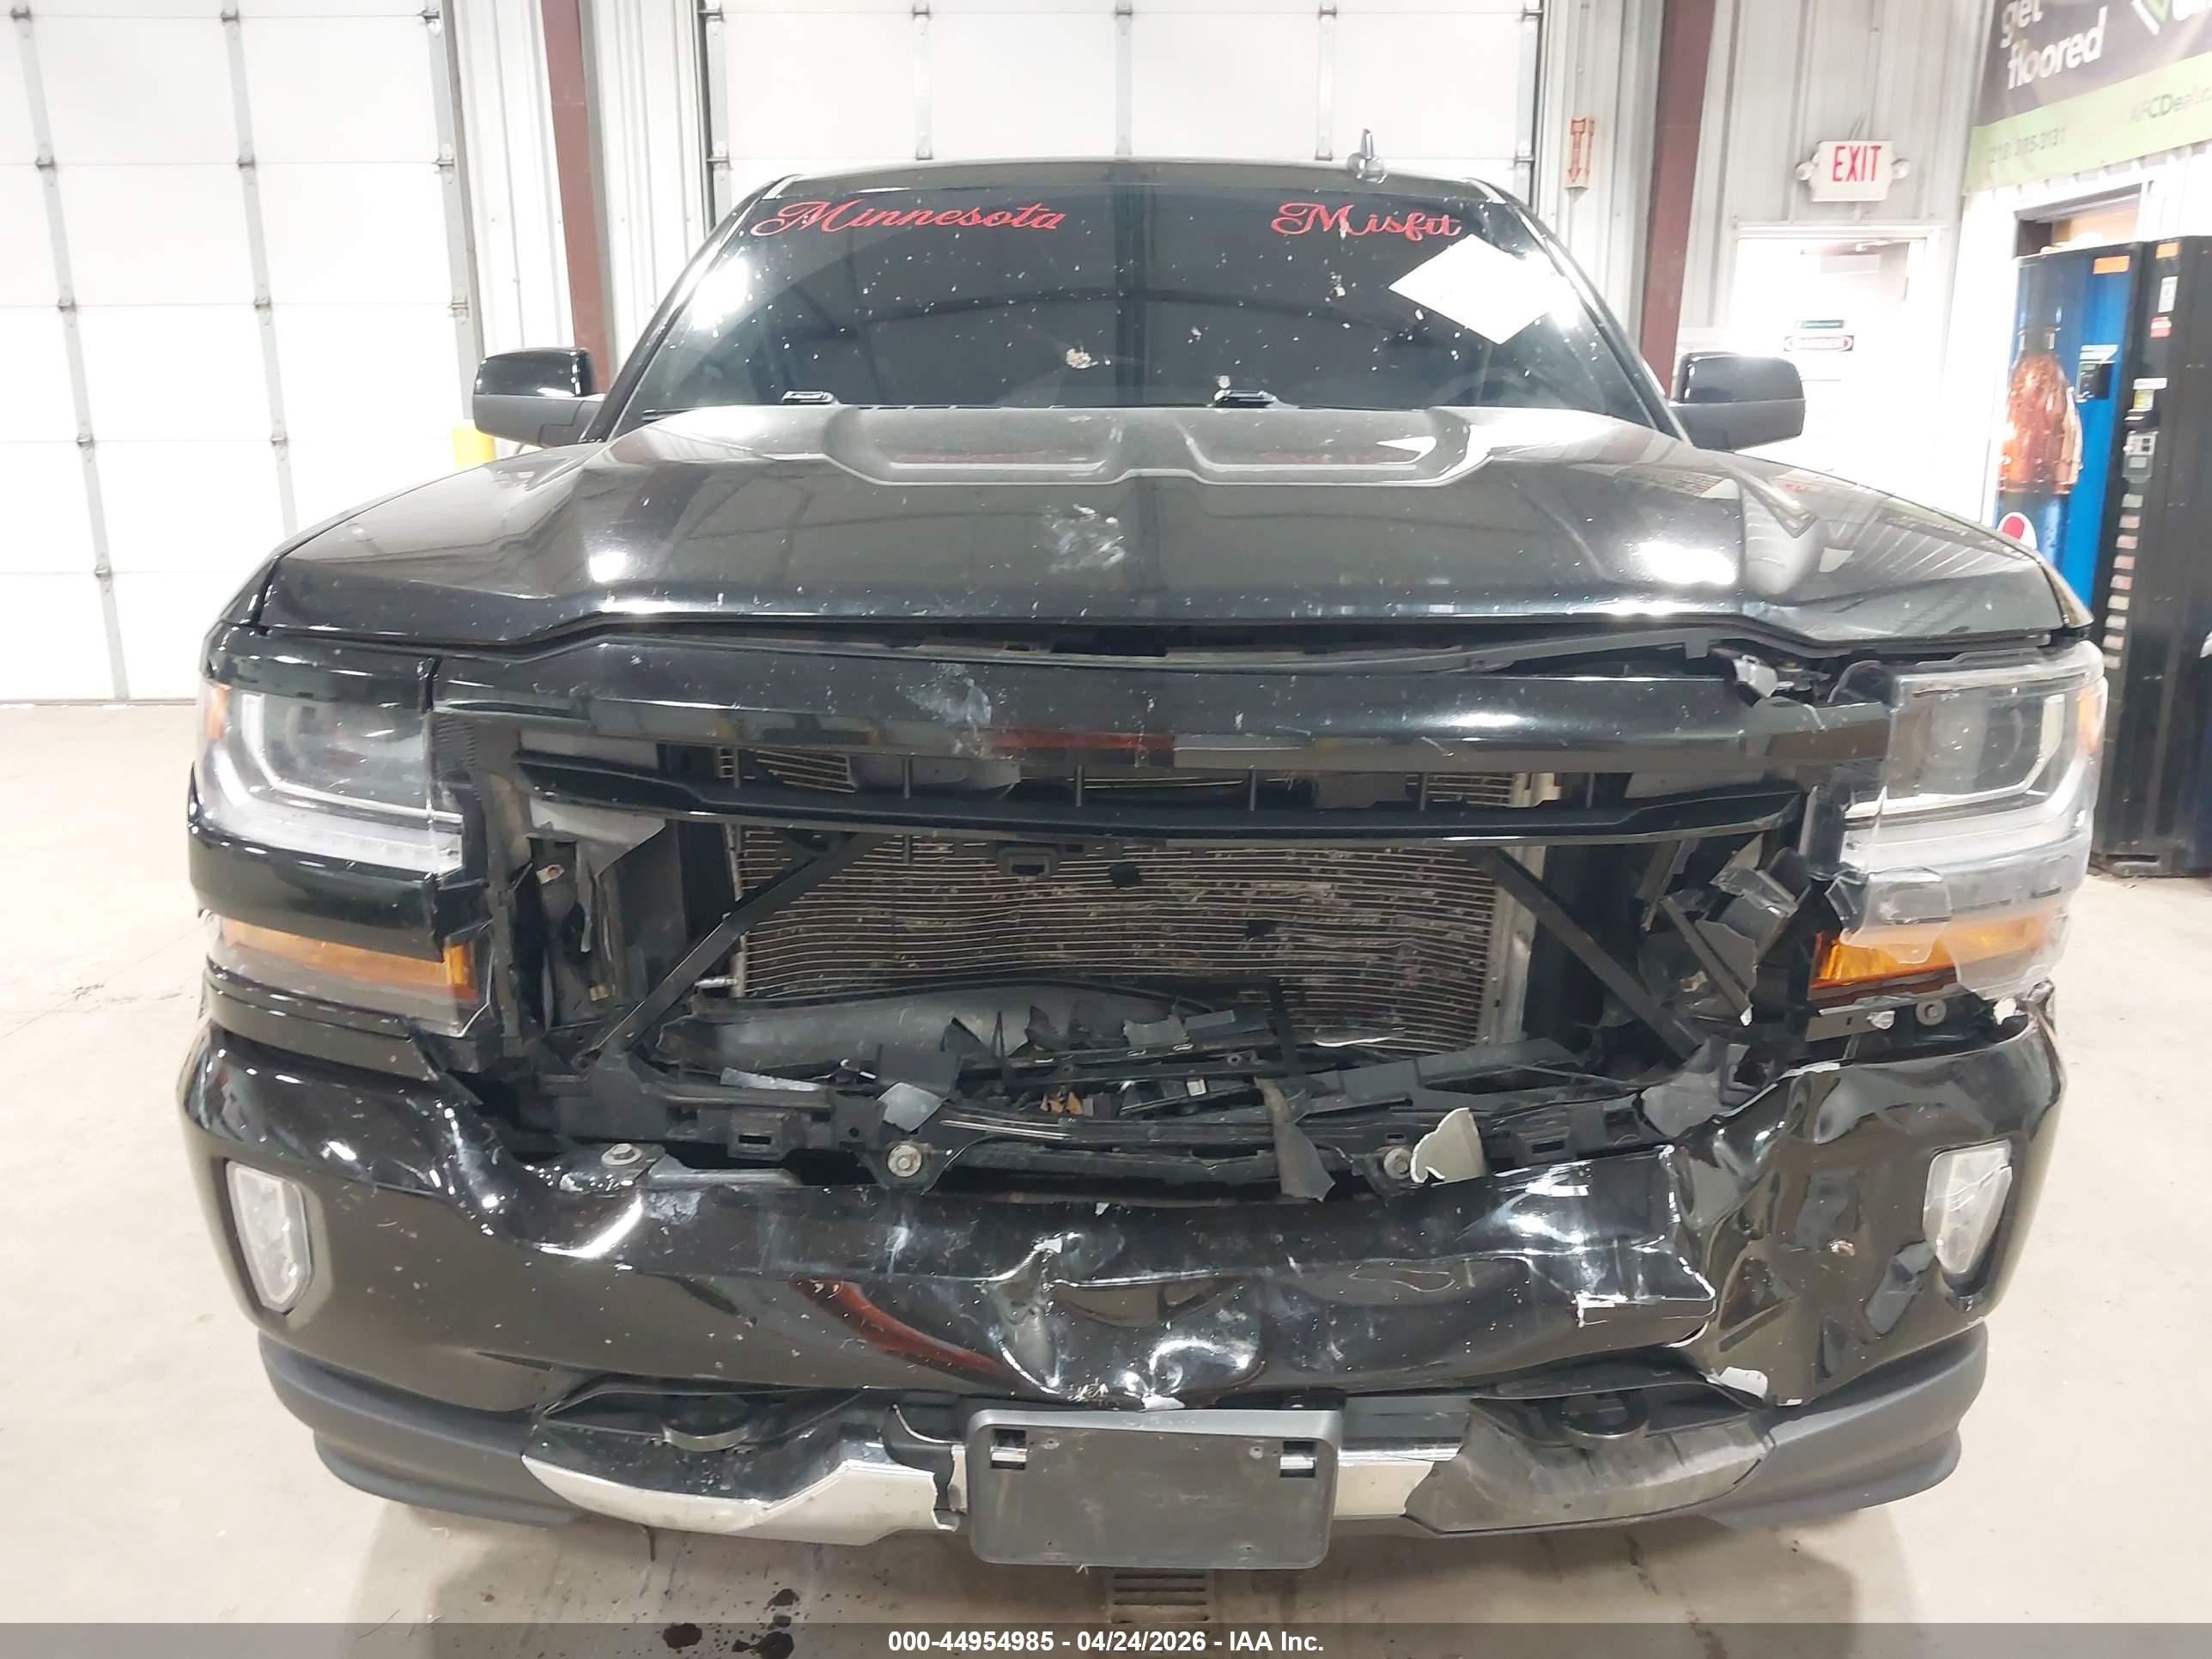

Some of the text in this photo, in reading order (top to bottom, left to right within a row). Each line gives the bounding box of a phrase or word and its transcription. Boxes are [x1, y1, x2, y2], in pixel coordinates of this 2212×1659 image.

[2007, 5, 2109, 90] floored
[1832, 145, 1882, 182] EXIT
[750, 198, 1462, 242] Minnesota Misfit
